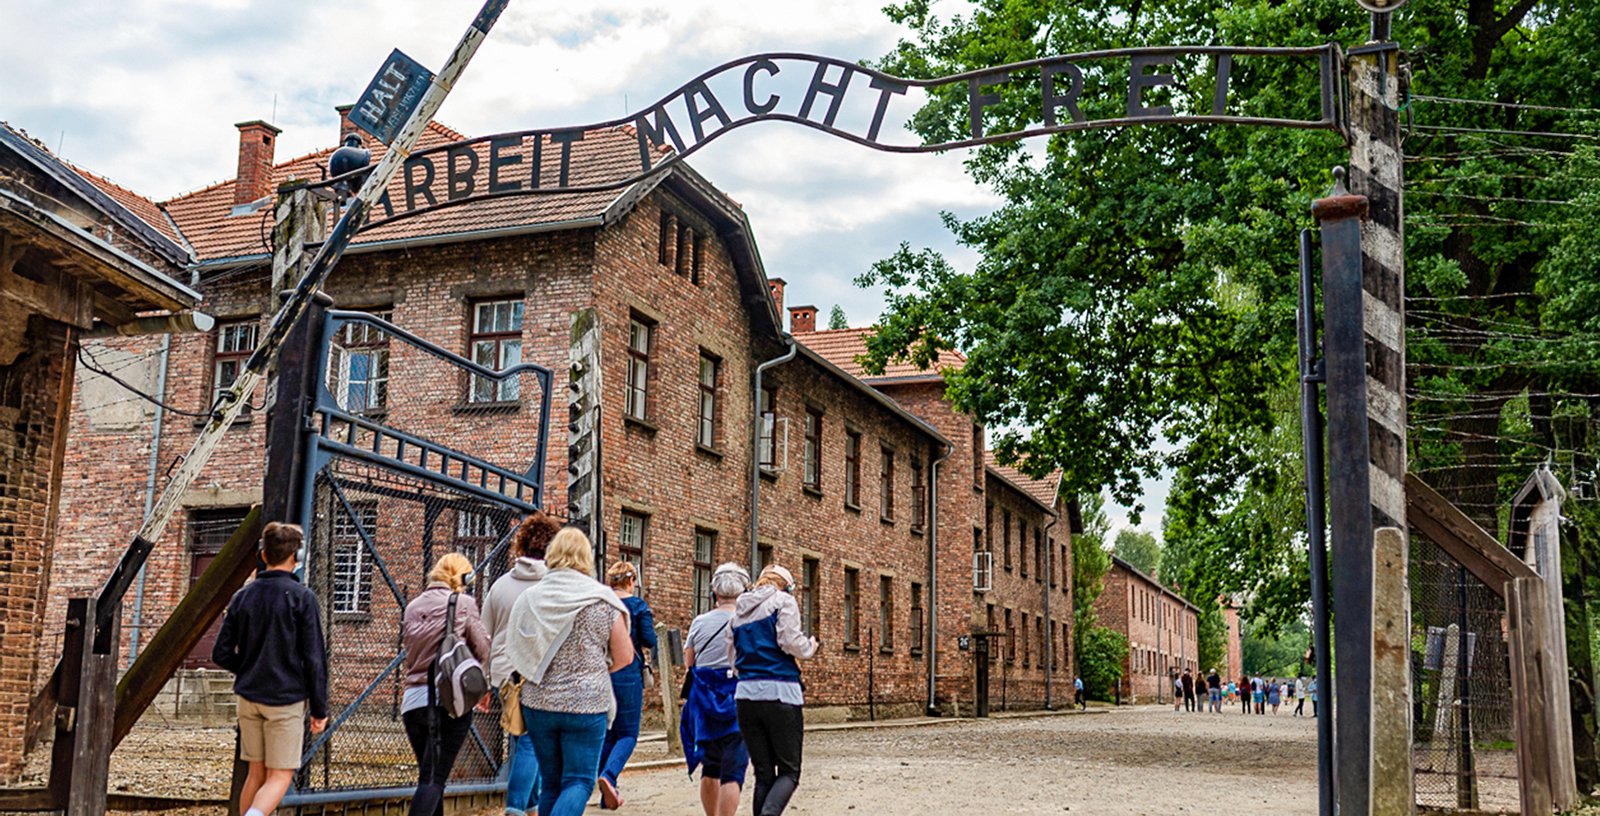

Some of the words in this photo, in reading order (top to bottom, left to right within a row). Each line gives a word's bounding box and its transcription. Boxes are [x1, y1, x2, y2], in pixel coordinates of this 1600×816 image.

[359, 62, 407, 123] HALT
[636, 59, 908, 172] MACHT
[968, 54, 1232, 139] FREI
